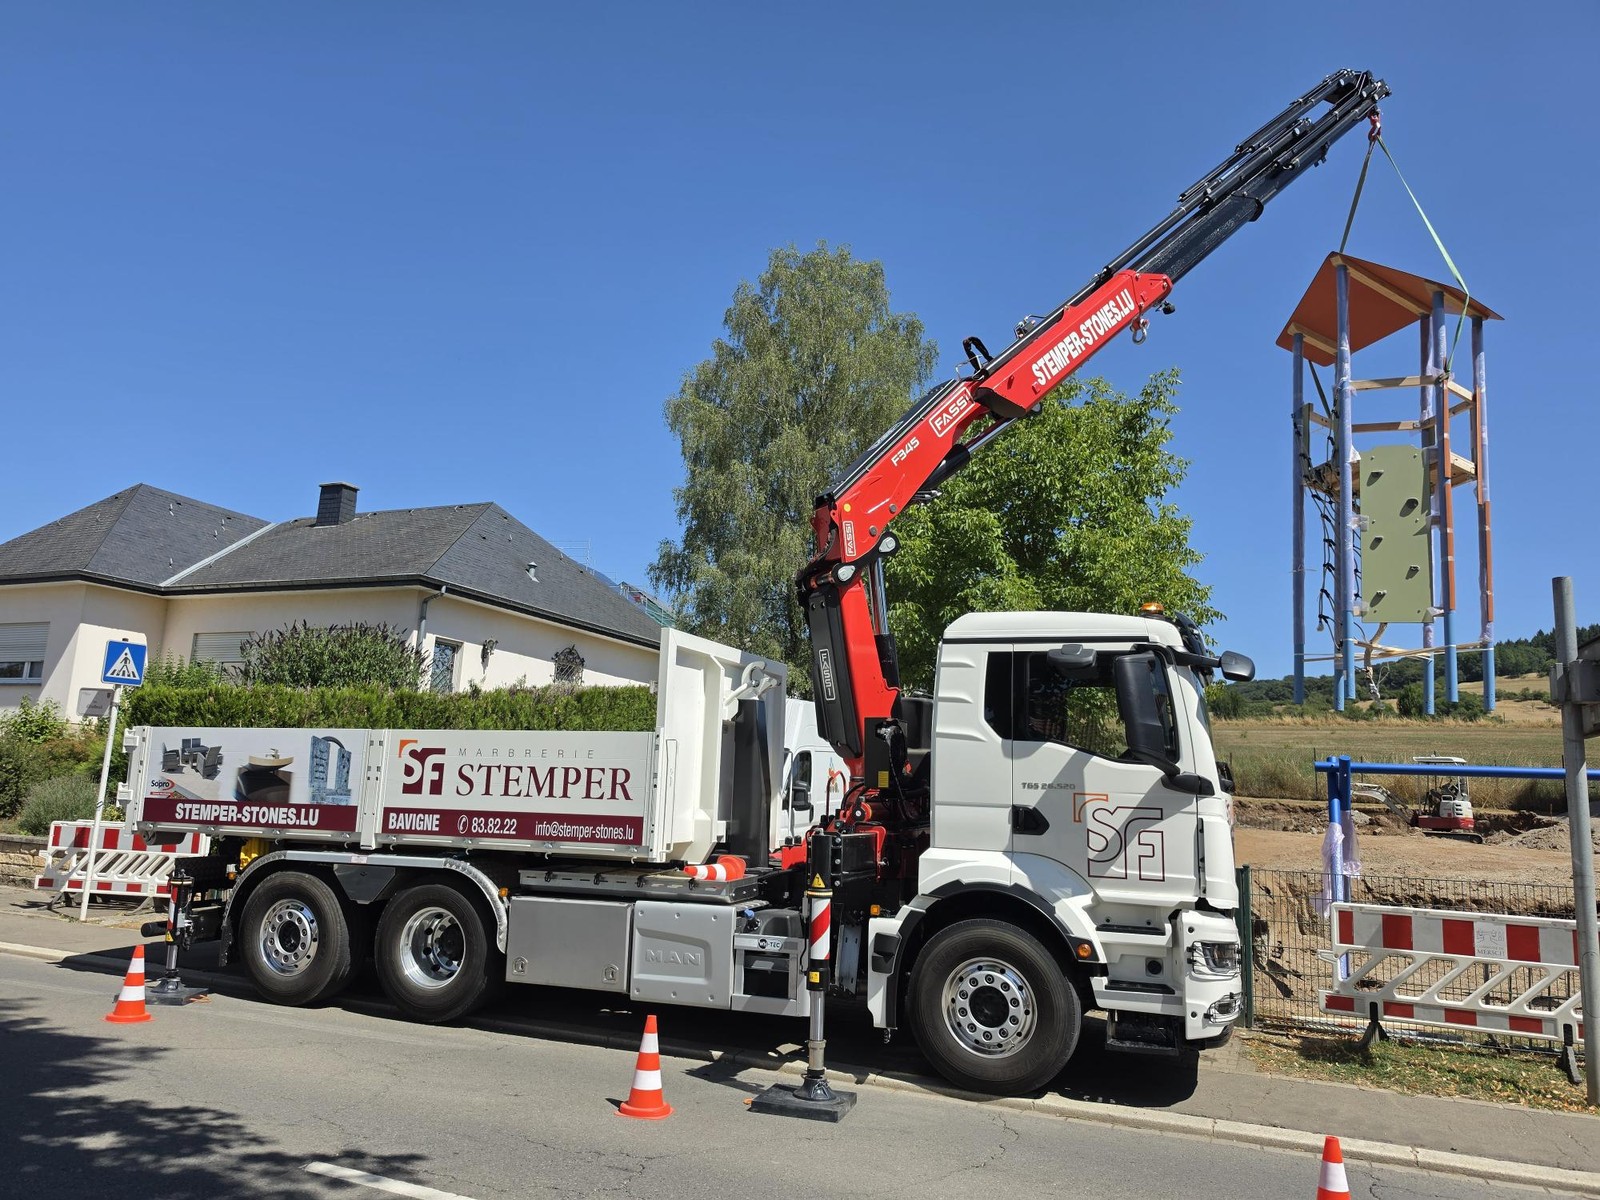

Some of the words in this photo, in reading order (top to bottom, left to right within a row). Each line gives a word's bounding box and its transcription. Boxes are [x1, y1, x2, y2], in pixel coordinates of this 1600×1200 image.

[1032, 289, 1135, 386] STEMPER-STONES.LU
[934, 394, 970, 431] FASSI
[891, 437, 920, 467] F345
[843, 522, 855, 555] FASSI
[821, 652, 833, 698] FASSI
[458, 748, 595, 760] MARBRERIE
[151, 779, 170, 789] Sopro
[456, 763, 633, 801] STEMPER
[175, 802, 319, 826] STEMPER-STONES.LU
[388, 812, 440, 831] BAVIGNE
[471, 817, 517, 835] 83.82.22
[535, 820, 634, 841] info@stemper-stones.lu
[645, 949, 701, 966] MAN
